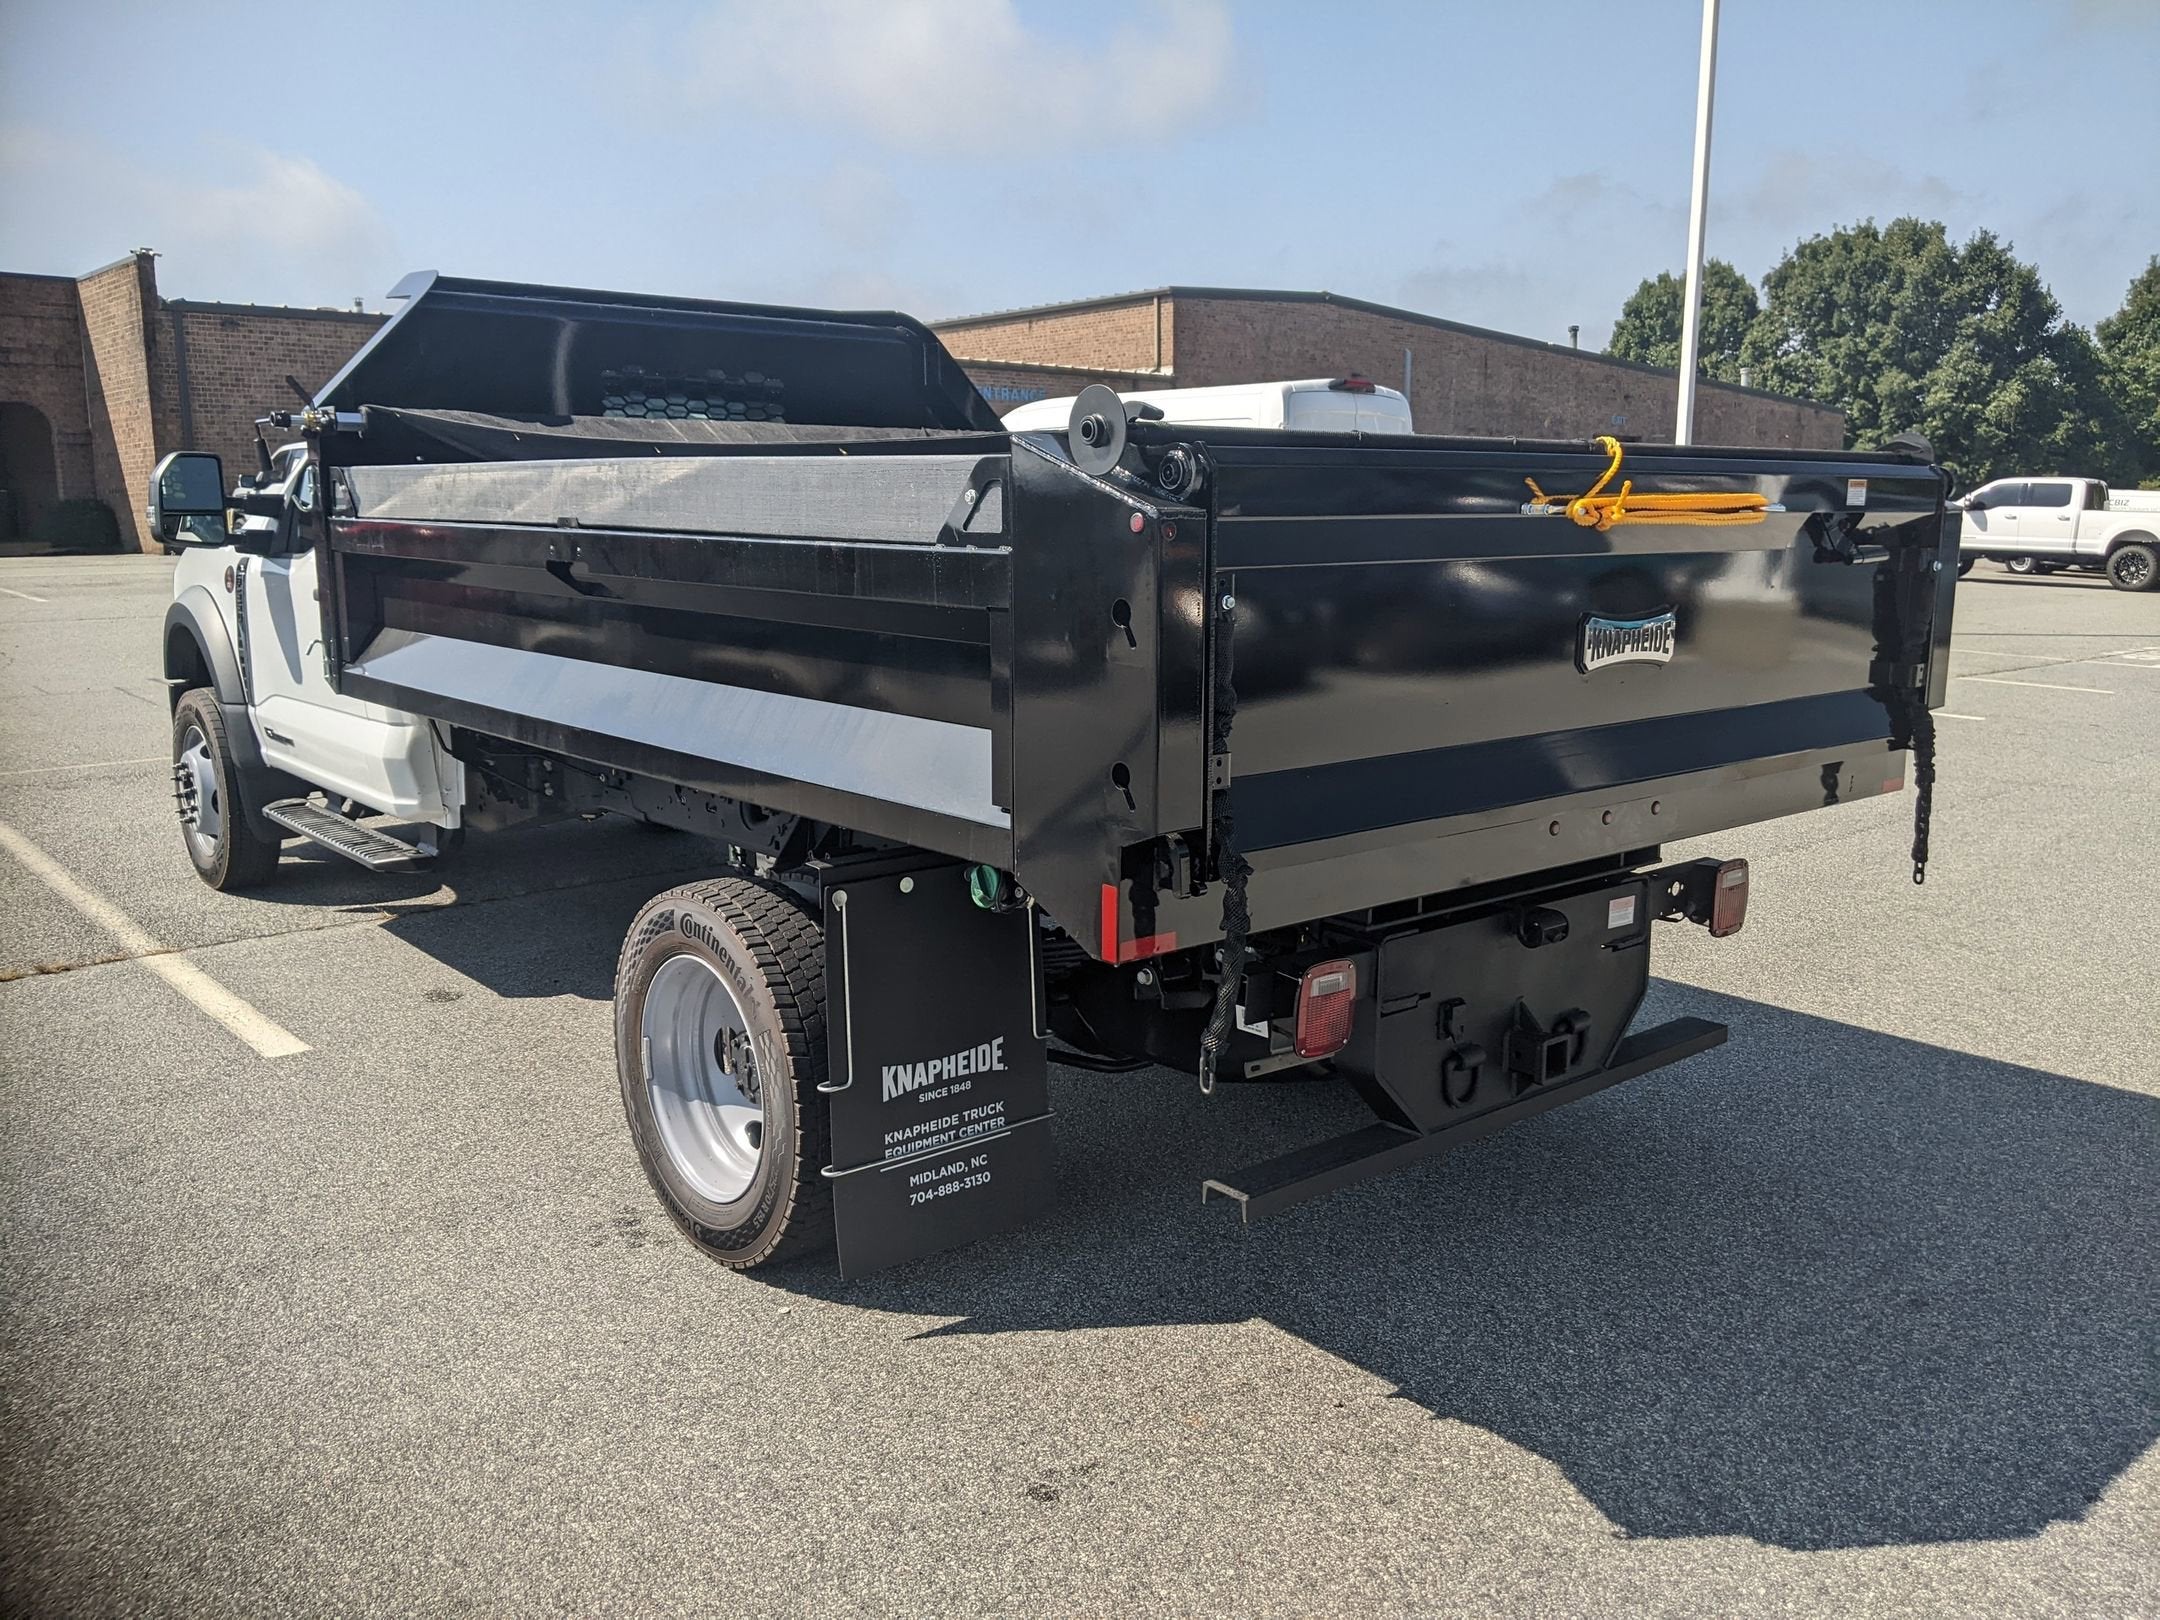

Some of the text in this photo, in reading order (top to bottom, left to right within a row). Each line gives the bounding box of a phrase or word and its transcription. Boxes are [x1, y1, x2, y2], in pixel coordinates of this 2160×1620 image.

[1588, 621, 1672, 662] KNAPHEIDE
[680, 912, 754, 999] Continental
[918, 1080, 971, 1103] SINCE 1848
[884, 1101, 1005, 1145] KNAPHEIDE TRUCK
[884, 1117, 1006, 1160] EQUIPMENT CENTER
[909, 1154, 988, 1188] MIDLAND, NC
[909, 1171, 991, 1206] 704-888-3130
